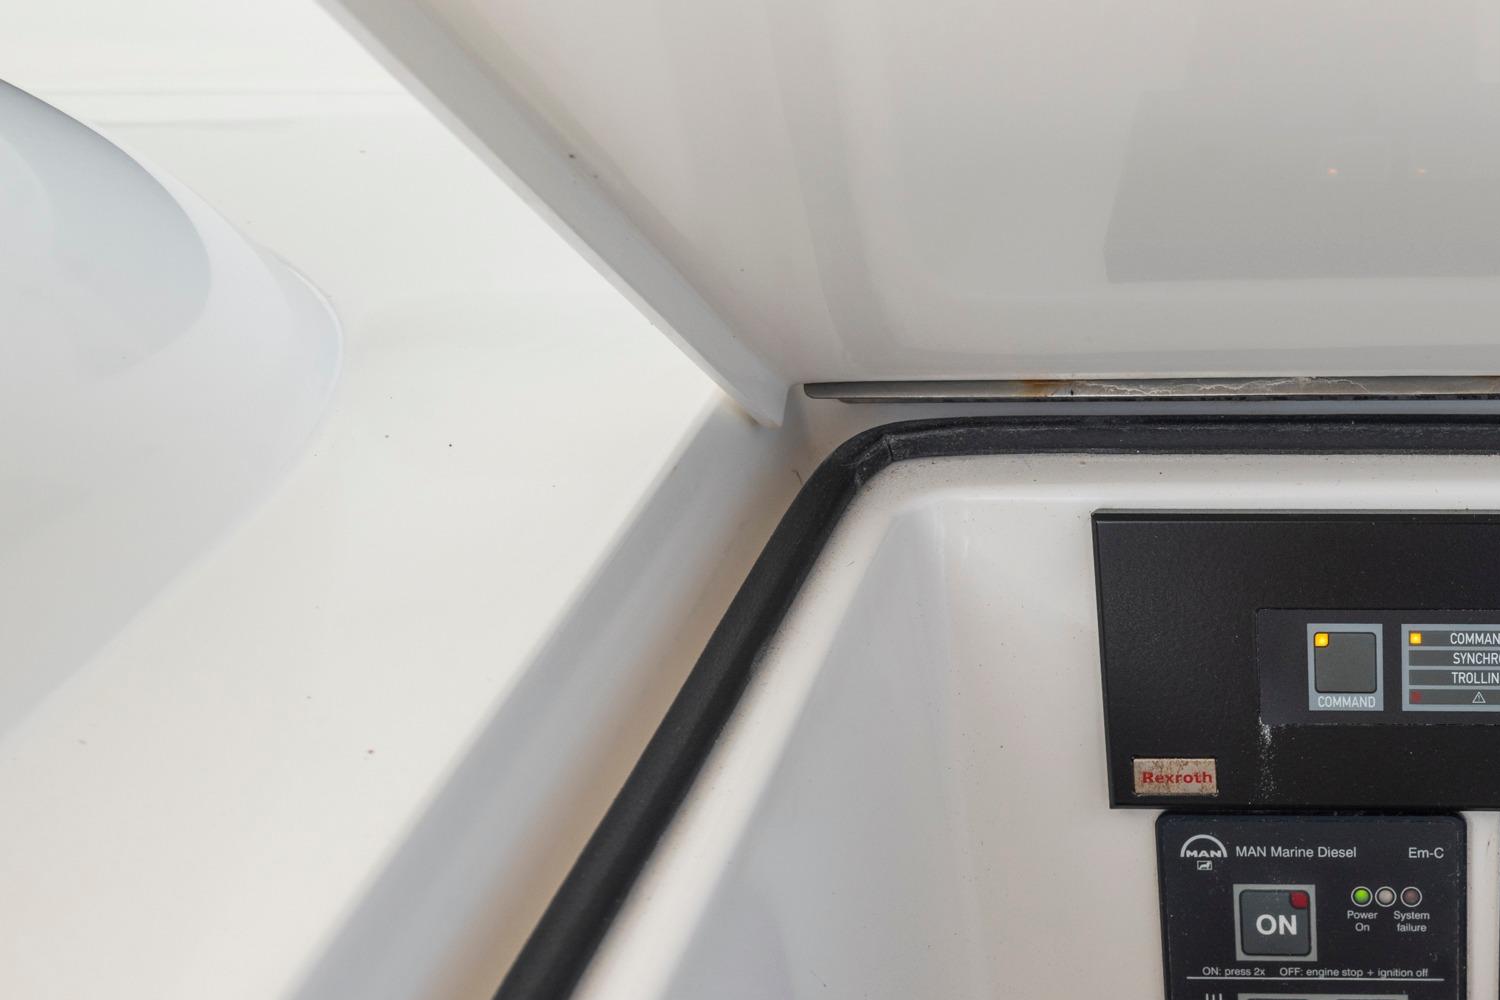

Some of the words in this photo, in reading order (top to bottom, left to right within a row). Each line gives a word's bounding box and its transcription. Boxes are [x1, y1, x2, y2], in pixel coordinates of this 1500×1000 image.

[1317, 695, 1376, 709] COMMAND
[1141, 771, 1213, 784] Rexroth
[1235, 846, 1267, 858] MAN
[1270, 846, 1314, 858] Marine
[1317, 846, 1357, 859] Diesel
[1407, 847, 1445, 859] Em-C
[1347, 910, 1378, 920] Power
[1393, 910, 1430, 922] System
[1255, 914, 1298, 936] ON
[1355, 922, 1370, 932] On
[1396, 922, 1427, 932] failure
[1202, 967, 1221, 976] ON:
[1224, 968, 1251, 978] press
[1254, 967, 1265, 976] 2x
[1279, 967, 1303, 977] OFF:
[1306, 968, 1339, 979] engine
[1341, 968, 1364, 978] stop
[1377, 967, 1414, 979] ignition
[1415, 967, 1429, 977] off
